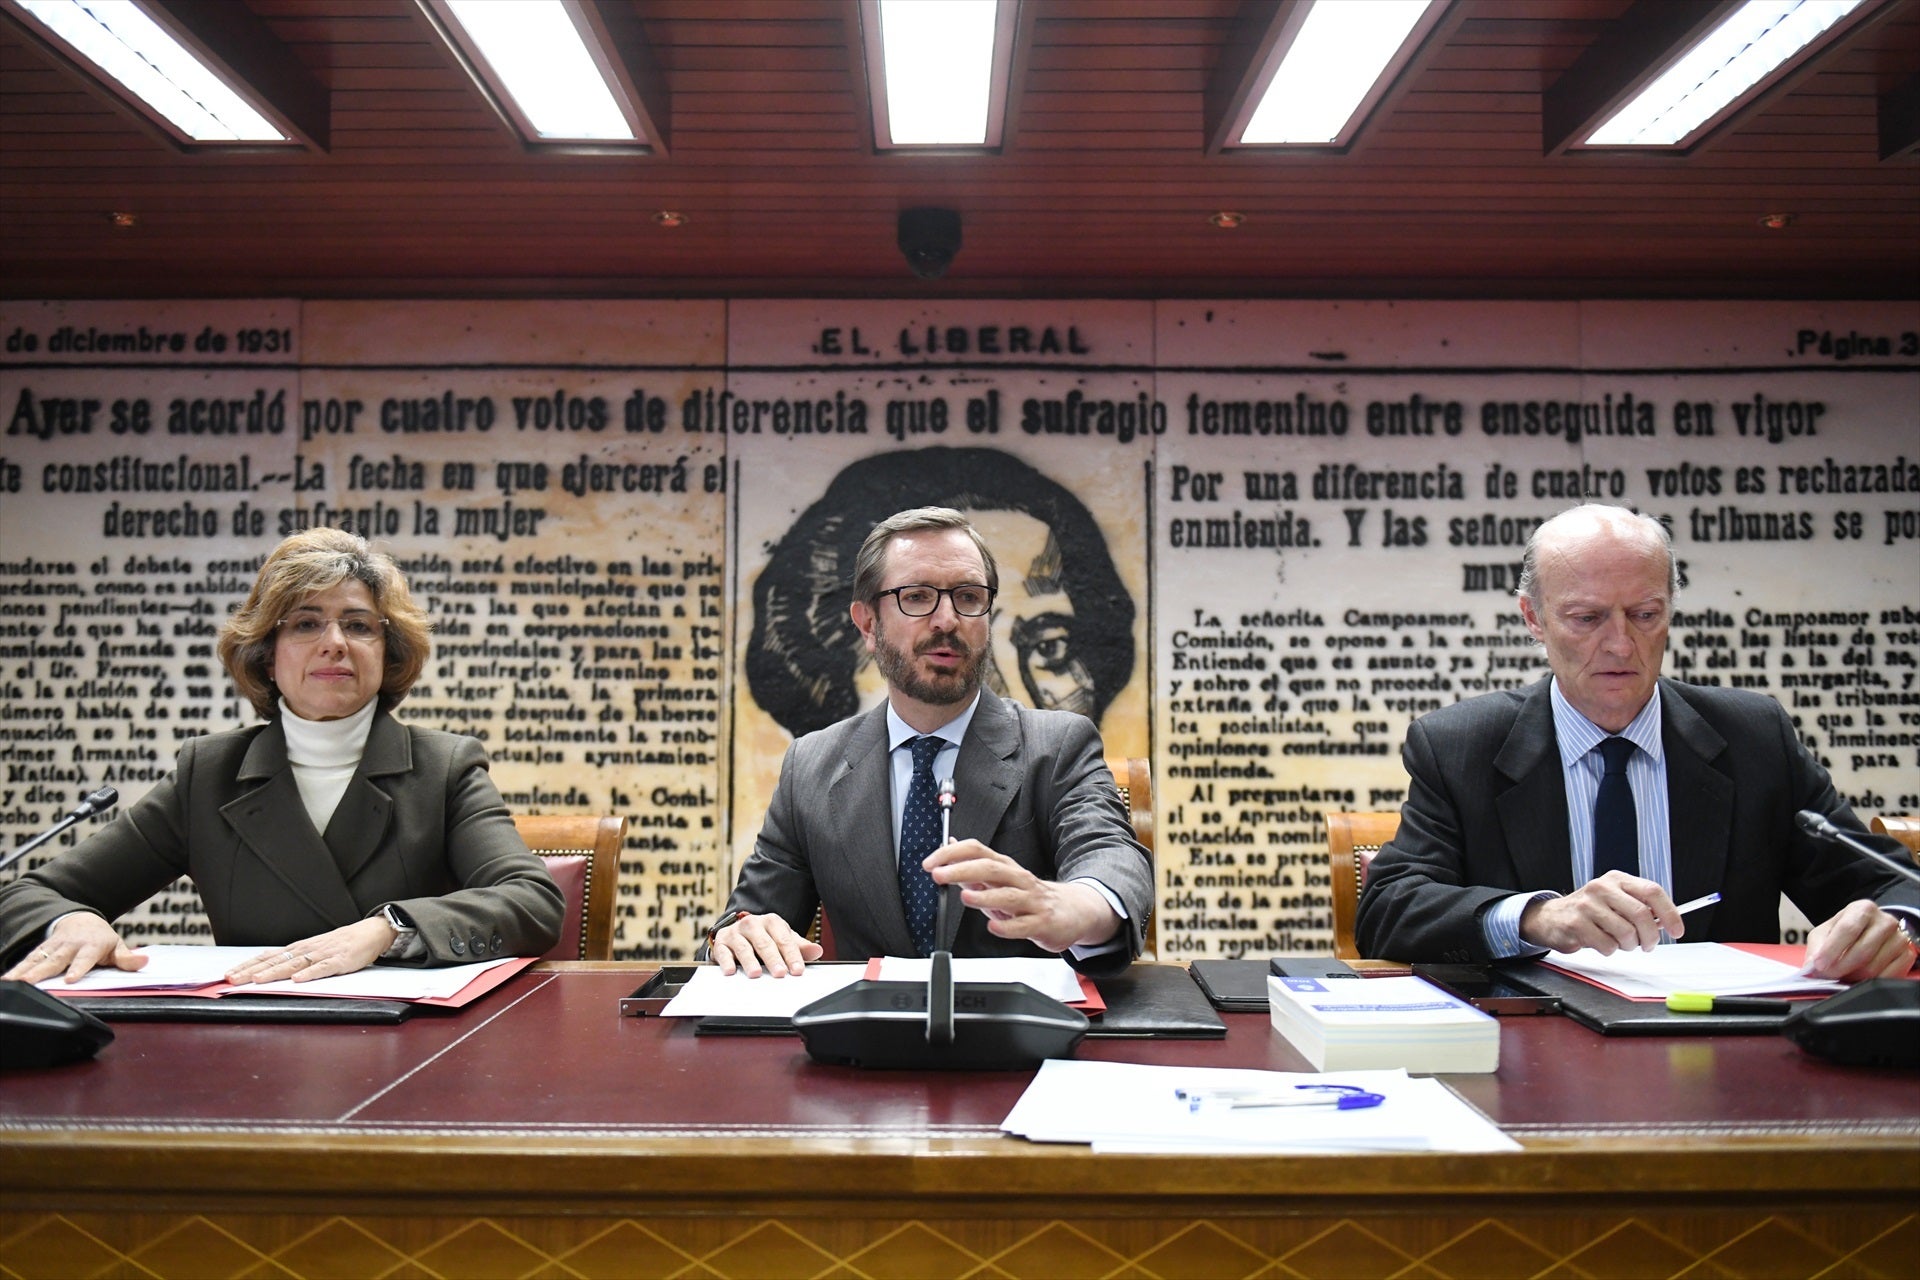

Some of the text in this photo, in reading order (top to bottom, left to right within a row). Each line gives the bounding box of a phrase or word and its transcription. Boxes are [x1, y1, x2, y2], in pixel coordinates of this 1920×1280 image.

[6, 326, 290, 353] de diciembre de 1931
[899, 326, 1090, 357] LIBERAL
[1798, 330, 1892, 360] Página
[7, 388, 1827, 443] Ayer se acordó por cuatro votos de diferencia que el sufragio femenino entre enseguida en vigor
[348, 454, 427, 490] fecha
[442, 462, 476, 491] en
[496, 462, 550, 496] que
[561, 454, 688, 497] ejercerá
[704, 451, 727, 494] el
[1171, 461, 1920, 502] Por una diferencia de cuatro votos es rechazada
[103, 501, 218, 537] derecho
[232, 501, 266, 537] de
[413, 499, 440, 536] la
[1170, 510, 1321, 548] enmienda.
[1343, 508, 1367, 546] Y
[1382, 509, 1428, 547] las
[1690, 507, 1815, 542] tribunas
[1834, 510, 1863, 540] se
